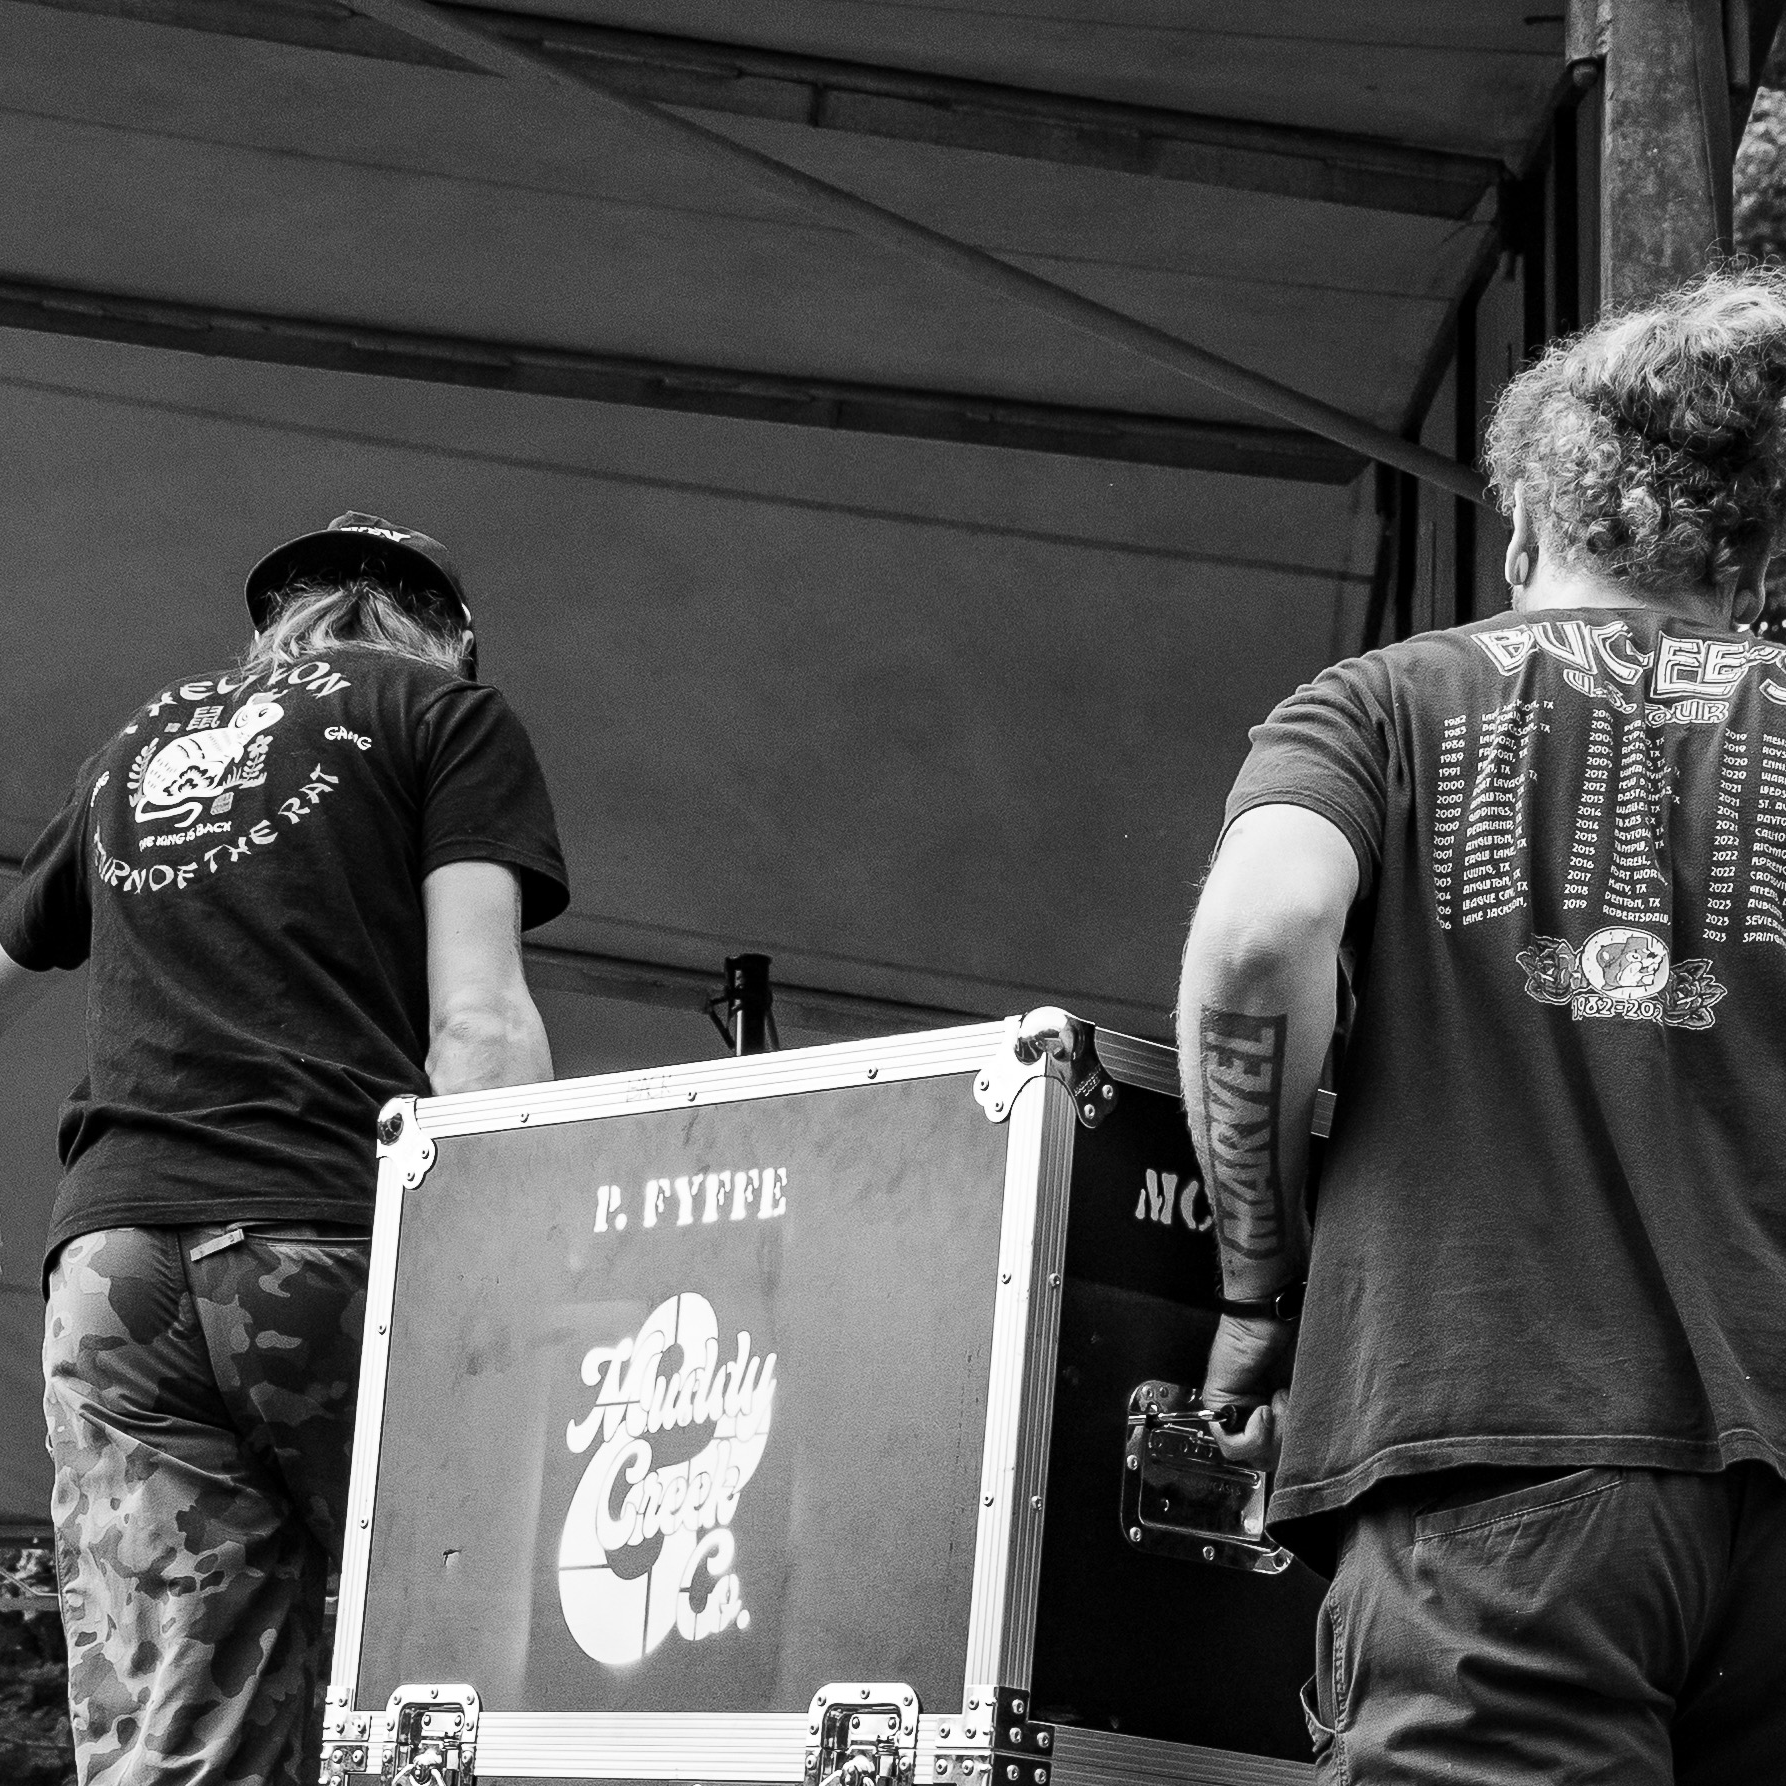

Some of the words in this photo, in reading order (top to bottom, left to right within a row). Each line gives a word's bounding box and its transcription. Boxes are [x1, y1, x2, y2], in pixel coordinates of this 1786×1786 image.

[324, 725, 372, 750] GANG
[1723, 754, 1749, 766] 2020
[1439, 767, 1461, 777] 1991
[1585, 769, 1608, 780] 2012
[1721, 767, 1747, 779] 2020
[1438, 780, 1465, 791] 2000
[1582, 781, 1606, 792] 2012
[1719, 780, 1742, 793] 2021
[1436, 794, 1463, 804] 2000
[1436, 808, 1461, 818] 2000
[1577, 806, 1602, 816] 2014
[149, 861, 199, 892] OF
[203, 819, 279, 874] THE
[277, 762, 340, 825] RAT
[195, 820, 232, 837] BACK
[1435, 821, 1459, 831] 2000
[1575, 818, 1599, 830] 2014
[1713, 835, 1740, 846] 2022
[1712, 850, 1739, 861] 2022
[1567, 870, 1592, 881] 2017
[1710, 866, 1736, 877] 2022
[1708, 882, 1734, 893] 2022
[1562, 899, 1588, 910] 2019
[1649, 898, 1661, 908] TX
[1207, 1020, 1279, 1253] MARVEL
[593, 1184, 628, 1233] P.
[642, 1167, 788, 1228] FYFFE
[1135, 1168, 1213, 1231] MC
[566, 1330, 778, 1454] Muddy
[596, 1438, 741, 1551] Creek
[676, 1527, 751, 1642] Co.
